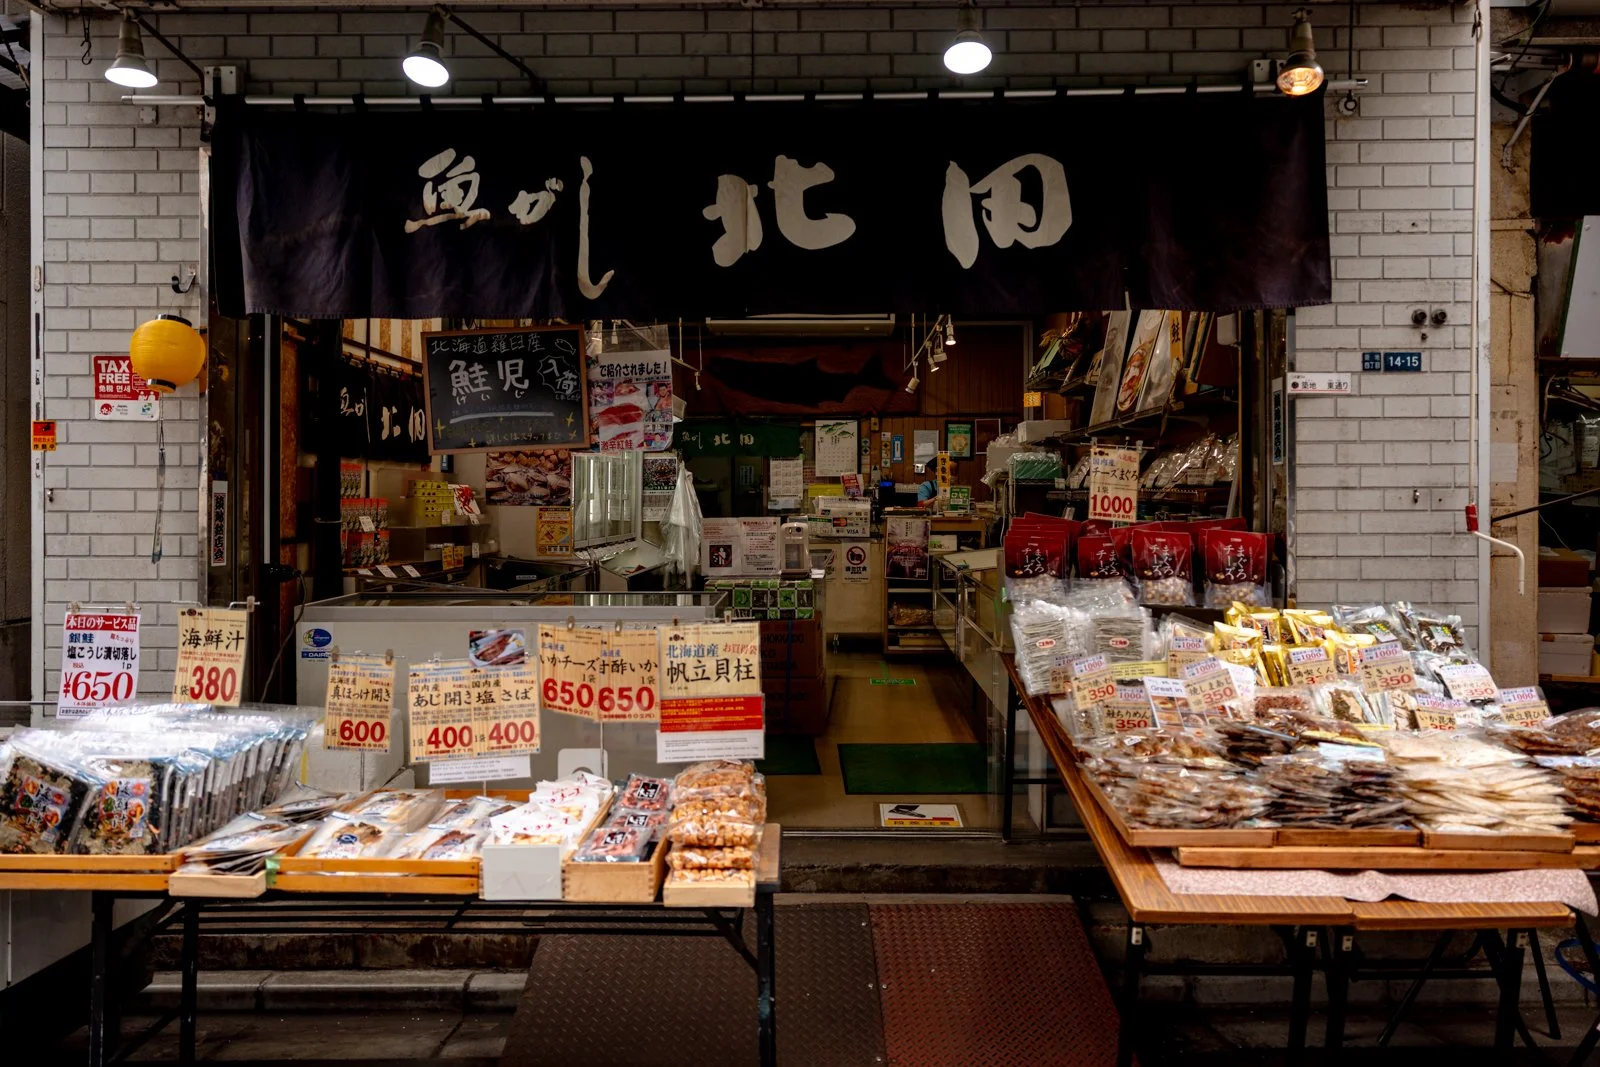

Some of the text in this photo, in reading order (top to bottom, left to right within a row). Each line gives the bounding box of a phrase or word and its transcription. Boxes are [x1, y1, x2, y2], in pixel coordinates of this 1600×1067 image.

[431, 333, 546, 354] 北海道羅臼産
[97, 360, 130, 373] TAX
[1389, 356, 1419, 367] 14-15
[98, 373, 130, 384] FREE
[448, 358, 529, 397] 鮭児
[541, 359, 578, 394] 入荷
[1092, 467, 1139, 480] チーズまぐろ
[1091, 495, 1133, 514] 1000
[1149, 544, 1163, 576] チーズ
[1224, 545, 1237, 580] チーズ
[1235, 545, 1247, 579] まぐろ
[67, 615, 137, 631] 本日のサービス品
[69, 633, 94, 644] 銀鮭
[182, 628, 245, 651] 海鮮汁
[67, 646, 137, 661] 塩こうじ漬切落し
[666, 643, 719, 659] 北海道産
[1301, 652, 1322, 660] 1000
[1375, 649, 1398, 658] 1000
[539, 654, 600, 671] いかチーズ
[666, 658, 756, 684] 帆立貝柱
[1084, 660, 1103, 671] 1000
[63, 671, 134, 701] ¥650
[190, 665, 237, 702] 380
[411, 683, 440, 692] 国内産
[471, 679, 501, 688] 国内産
[1379, 674, 1412, 687] 350
[331, 685, 391, 702] 真ほっけ開き
[413, 690, 471, 707] あじ開き
[476, 687, 534, 705] 塩さば
[543, 678, 594, 708] 650
[598, 686, 655, 712] 650
[1088, 685, 1115, 700] 350
[1203, 687, 1234, 704] 350
[340, 720, 386, 742] 600
[488, 720, 535, 744] 400
[1115, 719, 1148, 729] 350
[427, 725, 473, 749] 400
